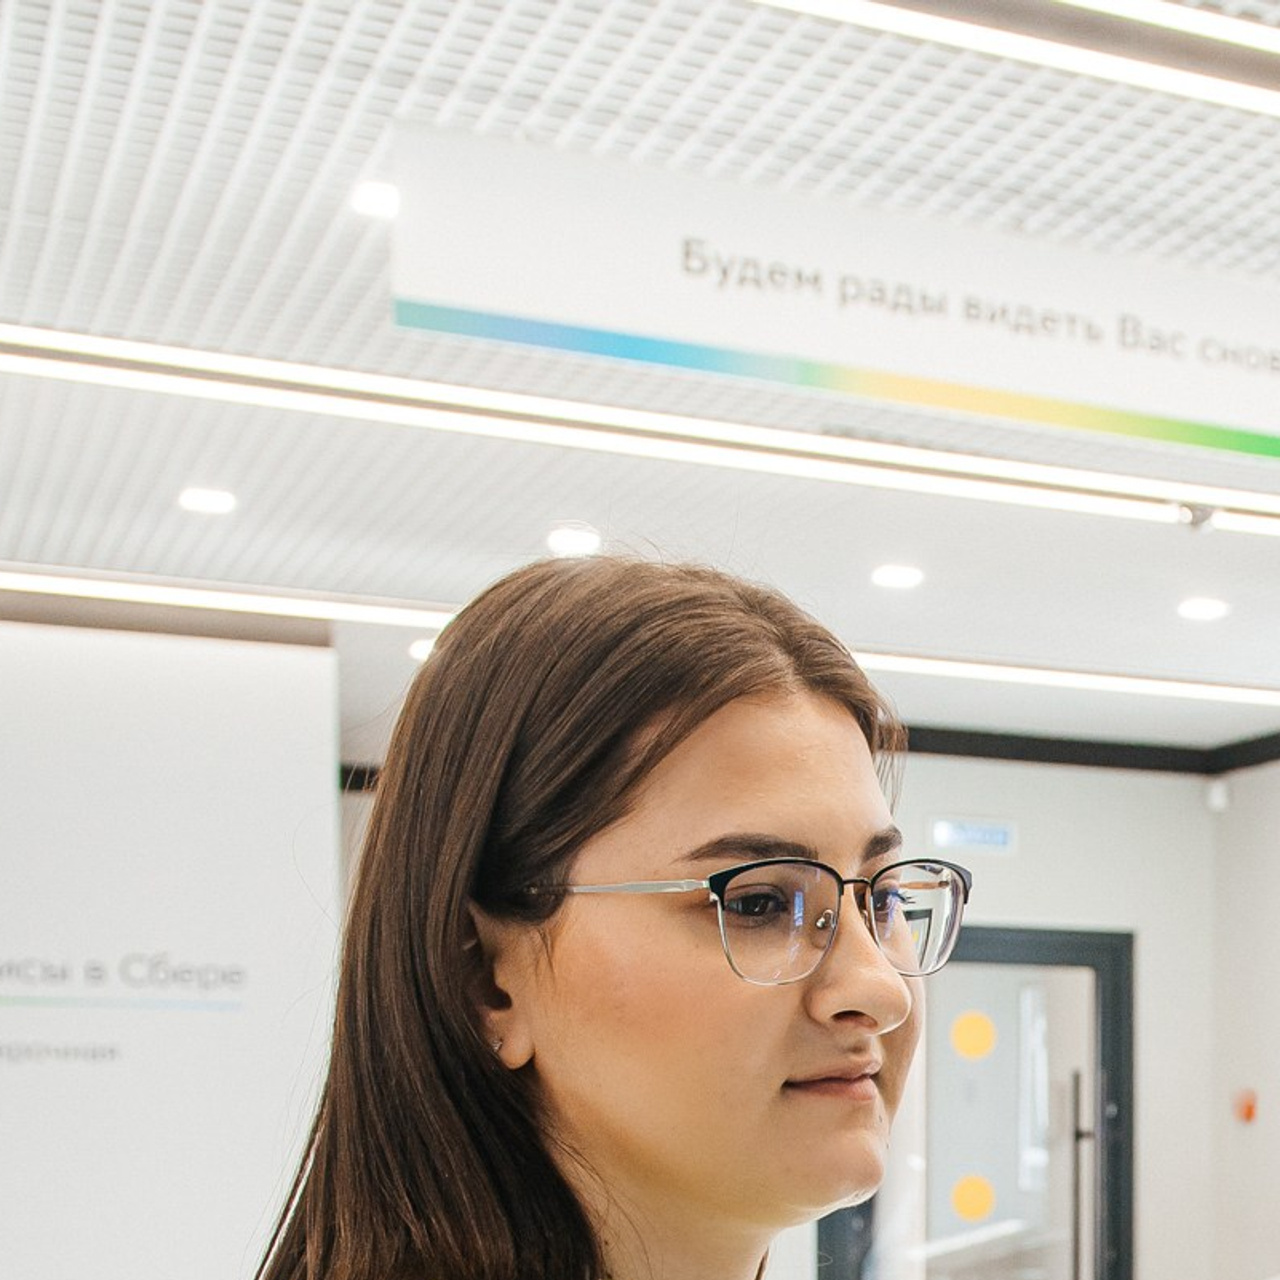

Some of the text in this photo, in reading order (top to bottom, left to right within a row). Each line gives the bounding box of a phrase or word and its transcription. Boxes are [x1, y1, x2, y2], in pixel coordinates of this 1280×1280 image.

[684, 239, 822, 292] Будем
[839, 274, 946, 313] рады
[964, 295, 1104, 341] видеть
[1118, 313, 1186, 356] Вас
[84, 960, 107, 985] в
[117, 951, 246, 990] Сбере
